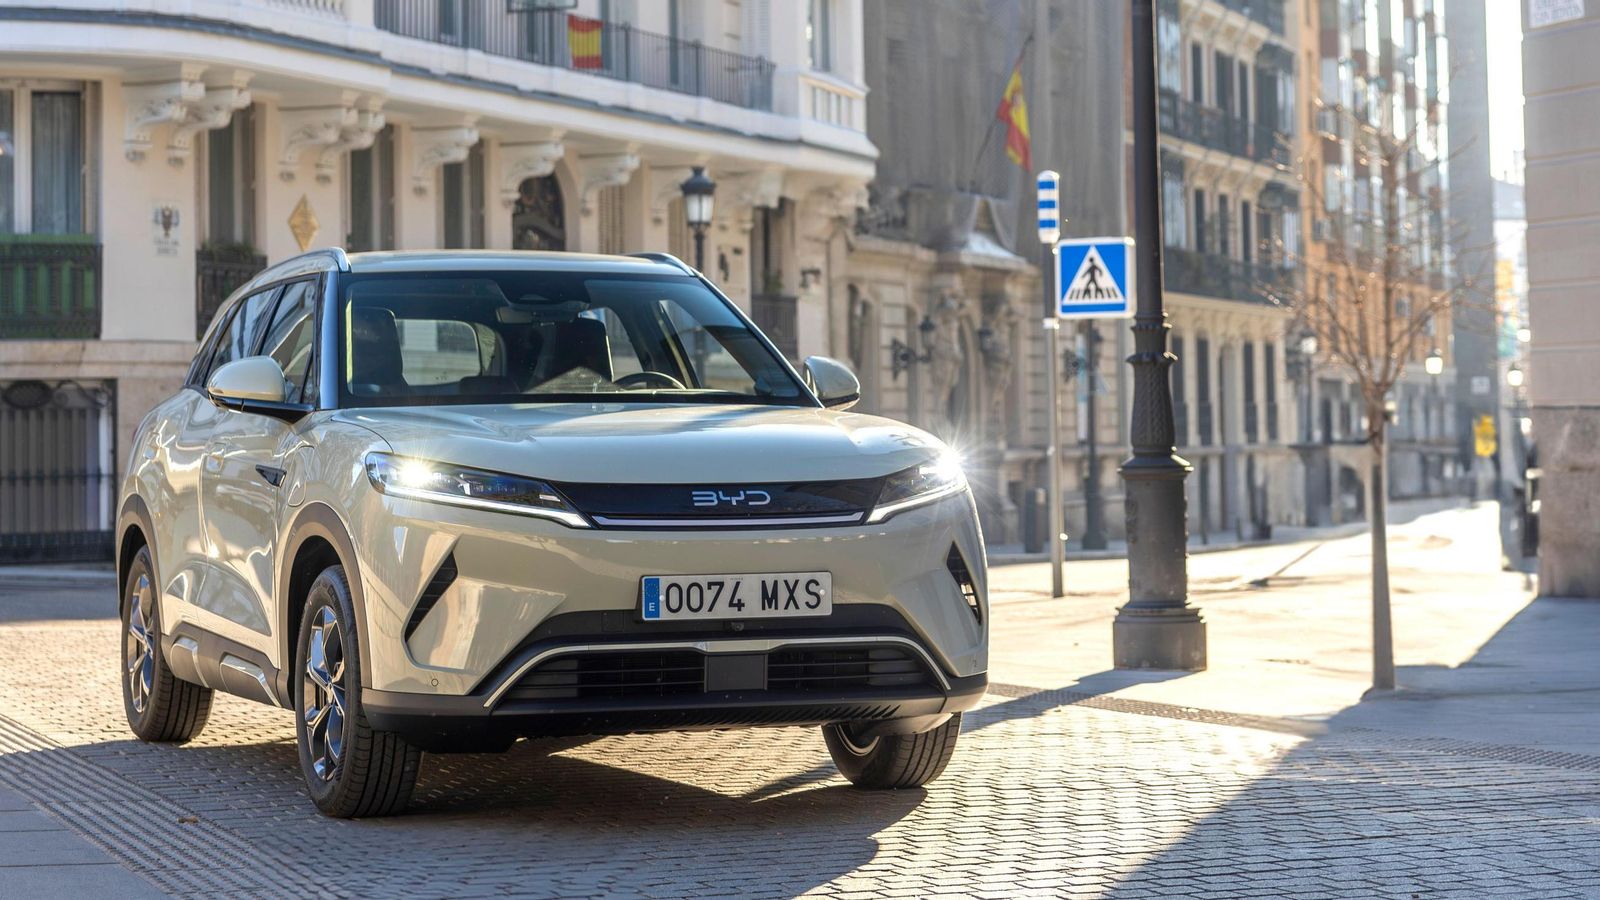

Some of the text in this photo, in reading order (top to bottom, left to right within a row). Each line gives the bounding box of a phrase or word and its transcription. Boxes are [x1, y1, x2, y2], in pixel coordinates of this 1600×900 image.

[691, 490, 771, 506] BYD
[665, 579, 821, 613] 0074 MXS
[648, 602, 655, 611] E
